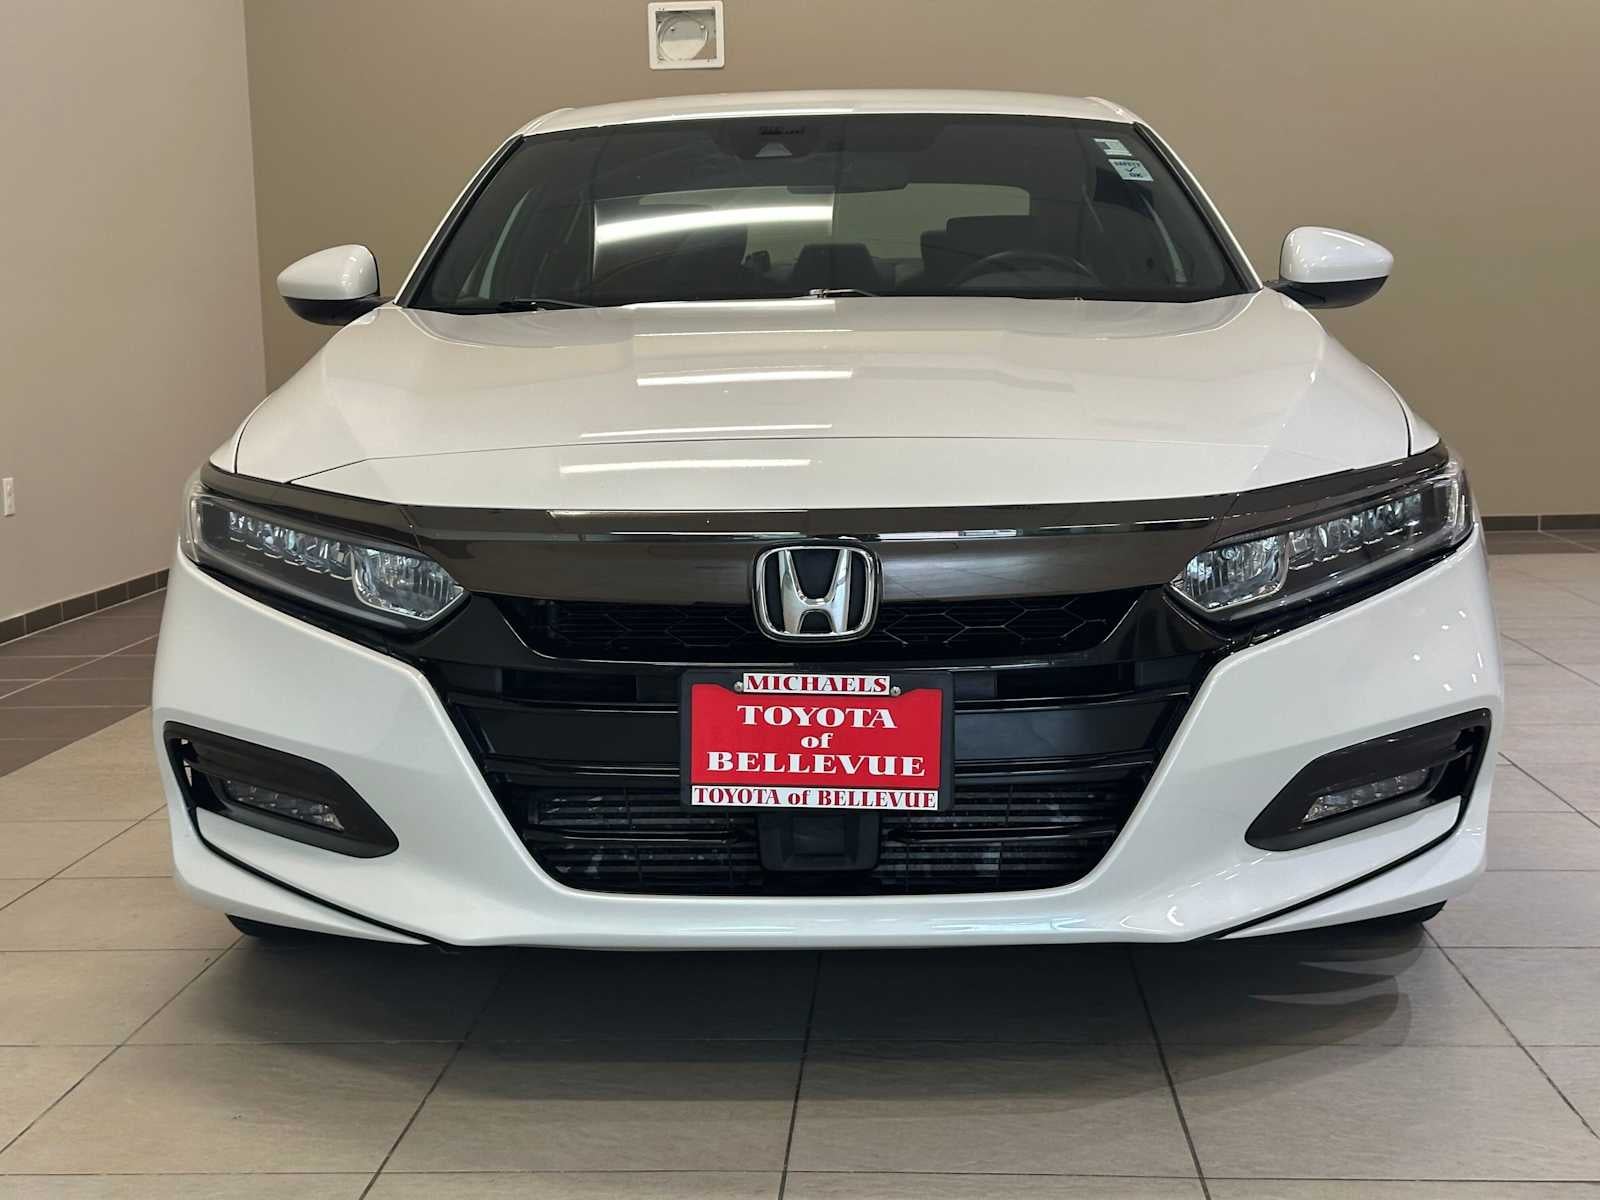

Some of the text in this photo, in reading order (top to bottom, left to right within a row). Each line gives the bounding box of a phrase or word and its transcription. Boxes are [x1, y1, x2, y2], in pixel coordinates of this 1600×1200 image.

[746, 674, 887, 693] MICHAELS
[737, 704, 898, 729] TOYOTA
[800, 732, 834, 749] of
[706, 751, 926, 777] BELLEVUE
[693, 787, 936, 809] TOYOTA of BELLEVUE
